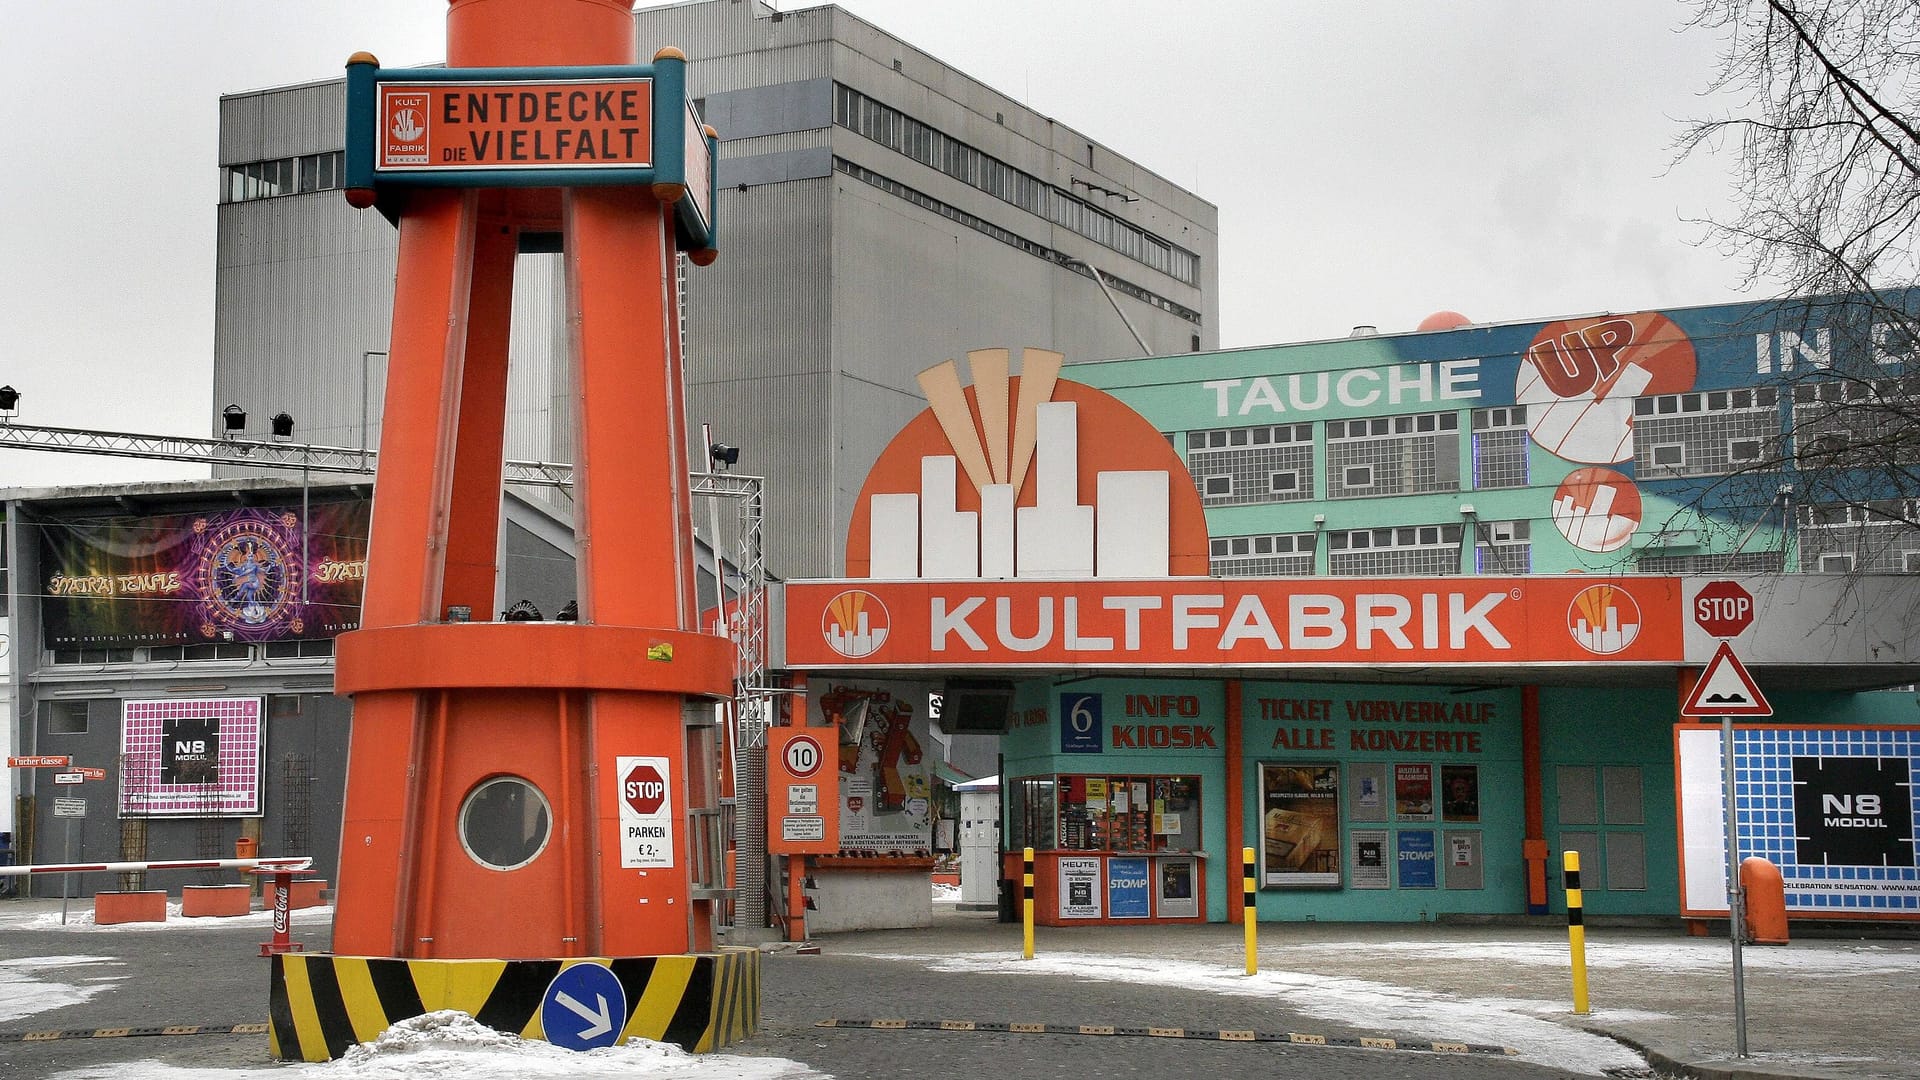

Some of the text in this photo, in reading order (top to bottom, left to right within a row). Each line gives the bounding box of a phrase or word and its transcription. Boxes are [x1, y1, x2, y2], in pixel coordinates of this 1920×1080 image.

[395, 98, 422, 107] KULT
[443, 91, 638, 124] ENTDECKE
[389, 145, 425, 153] FABRIK
[443, 128, 640, 162] DIE VIELFALT
[1529, 319, 1636, 399] UP
[1756, 327, 1831, 374] IN
[1203, 358, 1482, 417] TAUCHE
[1698, 597, 1750, 621] STOP
[930, 593, 1513, 652] KULTFABRIK
[1070, 695, 1093, 733] 6
[1125, 694, 1200, 718] INFO
[1258, 697, 1497, 725] TICKET VORVERKAUF
[175, 740, 206, 754] N8
[1111, 724, 1219, 750] KIOSK
[1271, 727, 1483, 753] ALLE KONZERTE
[793, 748, 813, 767] 10
[626, 781, 663, 799] STOP
[1821, 793, 1882, 815] N8
[628, 826, 666, 838] PARKEN
[1823, 817, 1888, 829] MODUL
[638, 844, 645, 855] €
[1399, 850, 1434, 861] STOMP
[1110, 878, 1147, 889] STOMP
